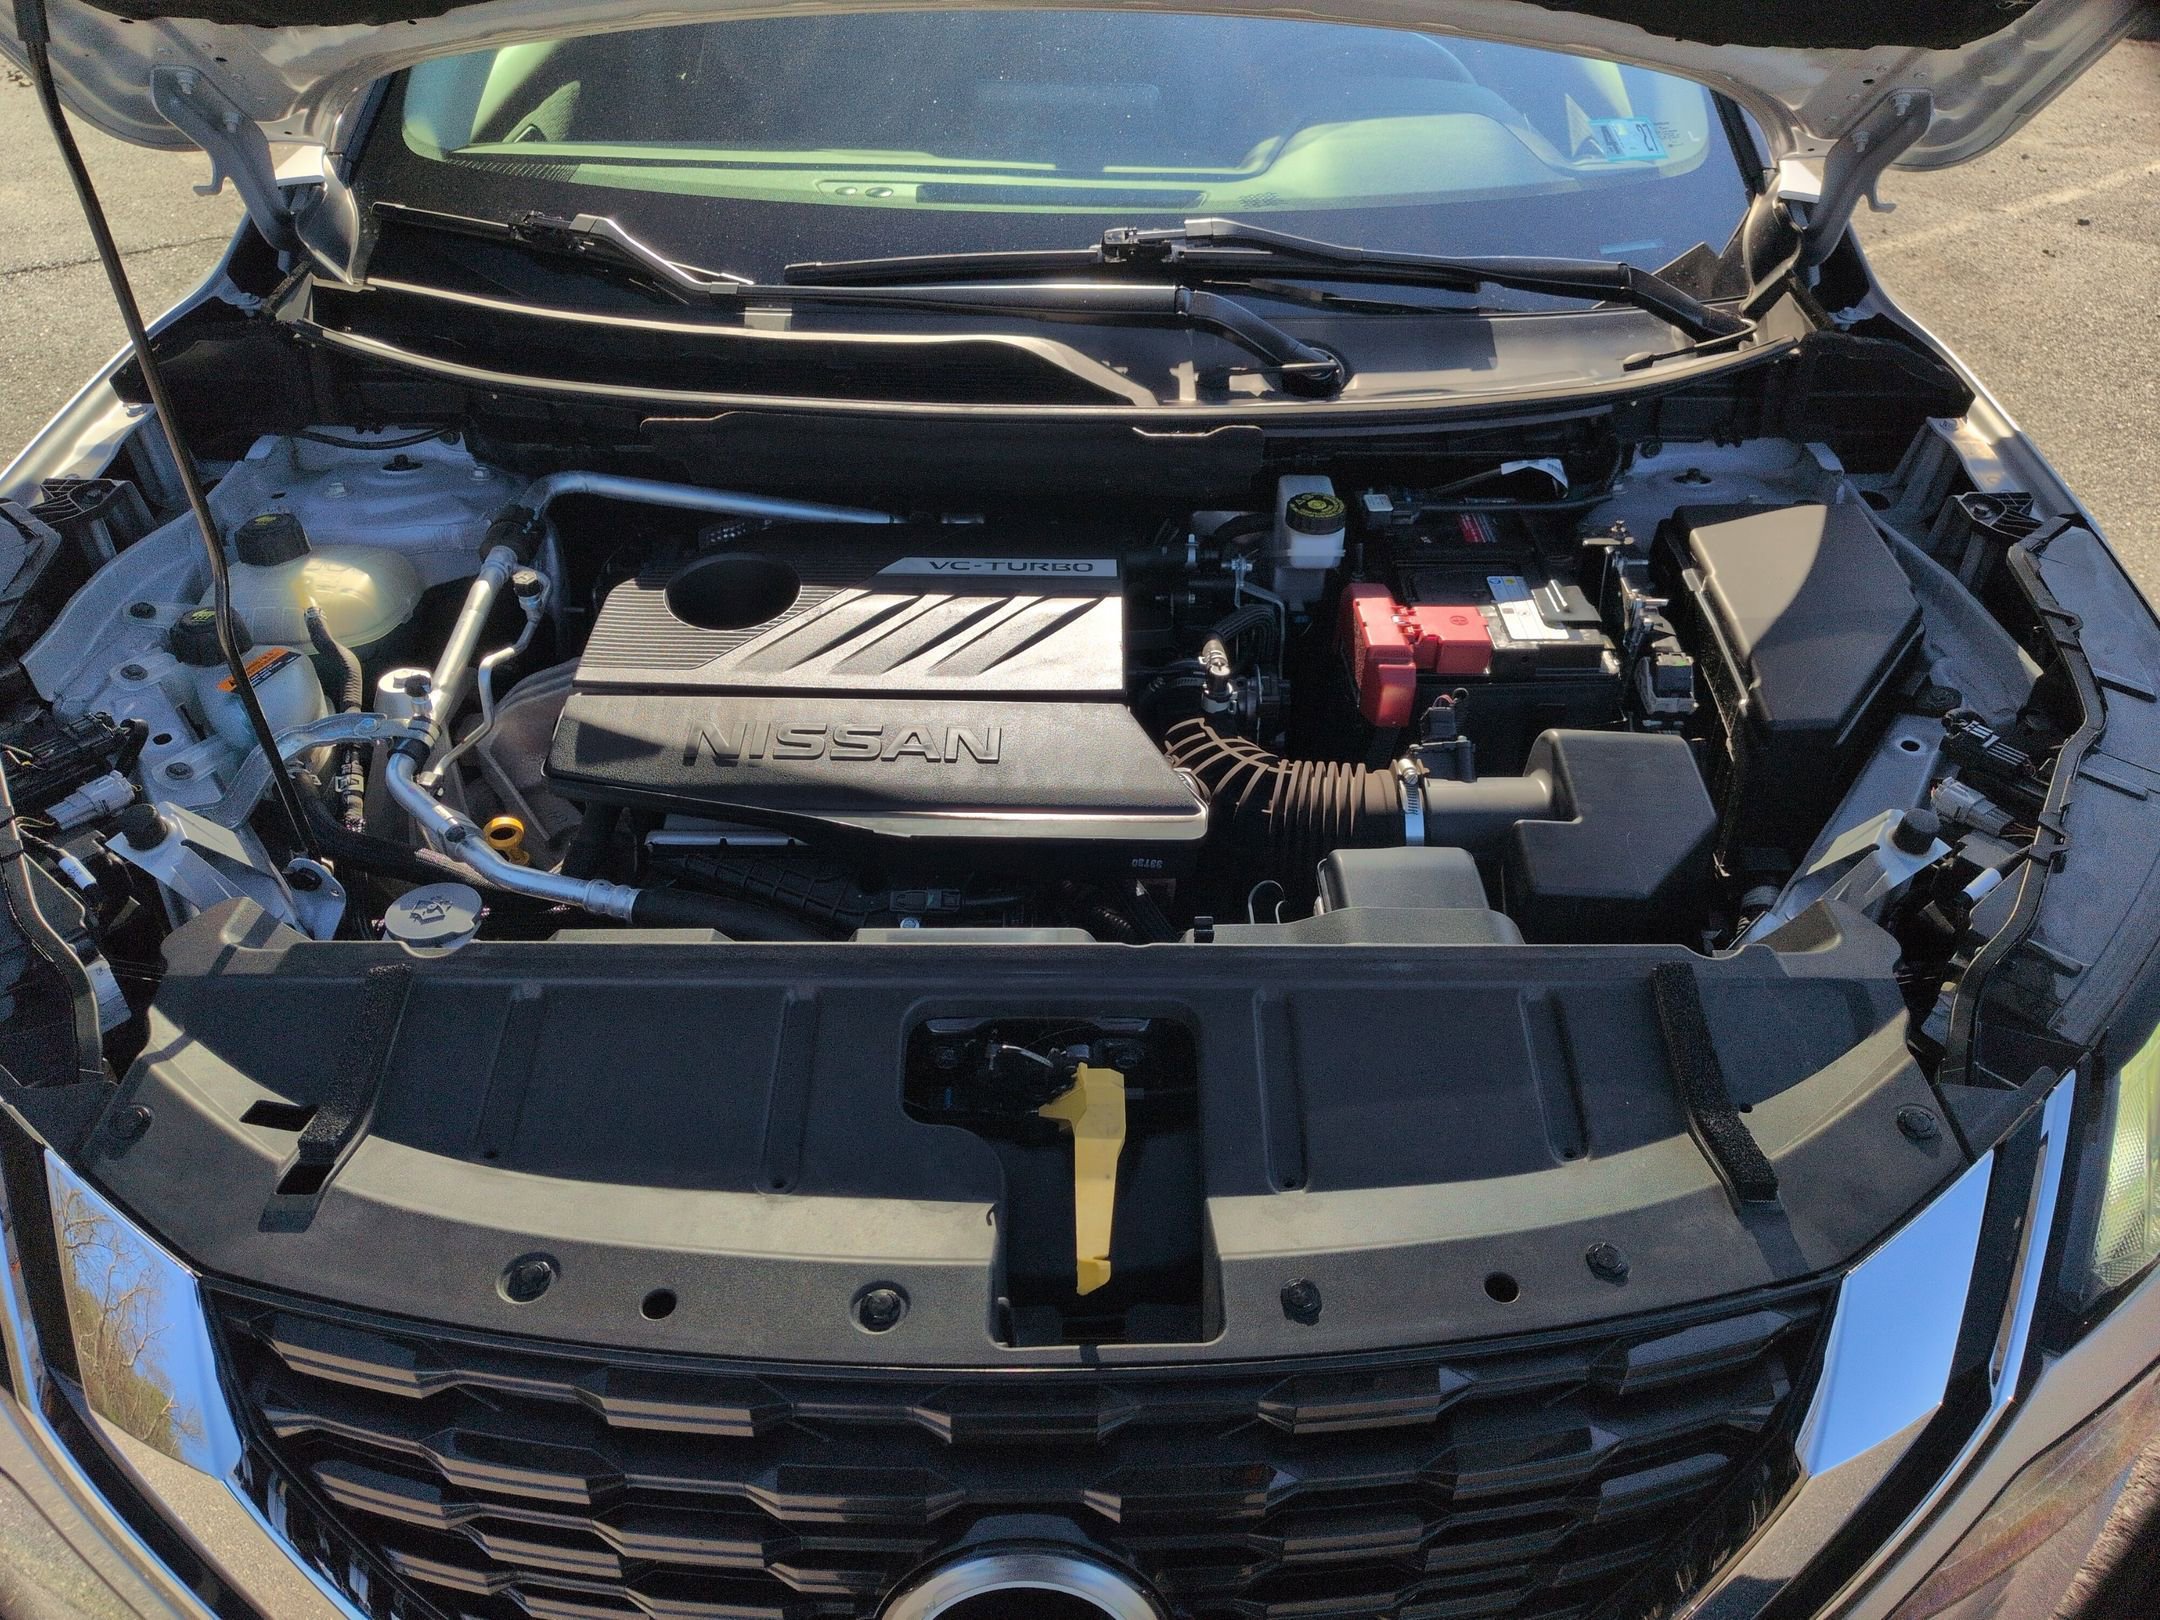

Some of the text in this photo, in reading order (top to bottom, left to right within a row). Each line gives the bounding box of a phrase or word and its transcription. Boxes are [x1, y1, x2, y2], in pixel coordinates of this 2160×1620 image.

[1636, 124, 1659, 152] 27
[929, 560, 1094, 573] VC-TURBO
[682, 721, 1002, 766] NISSAN
